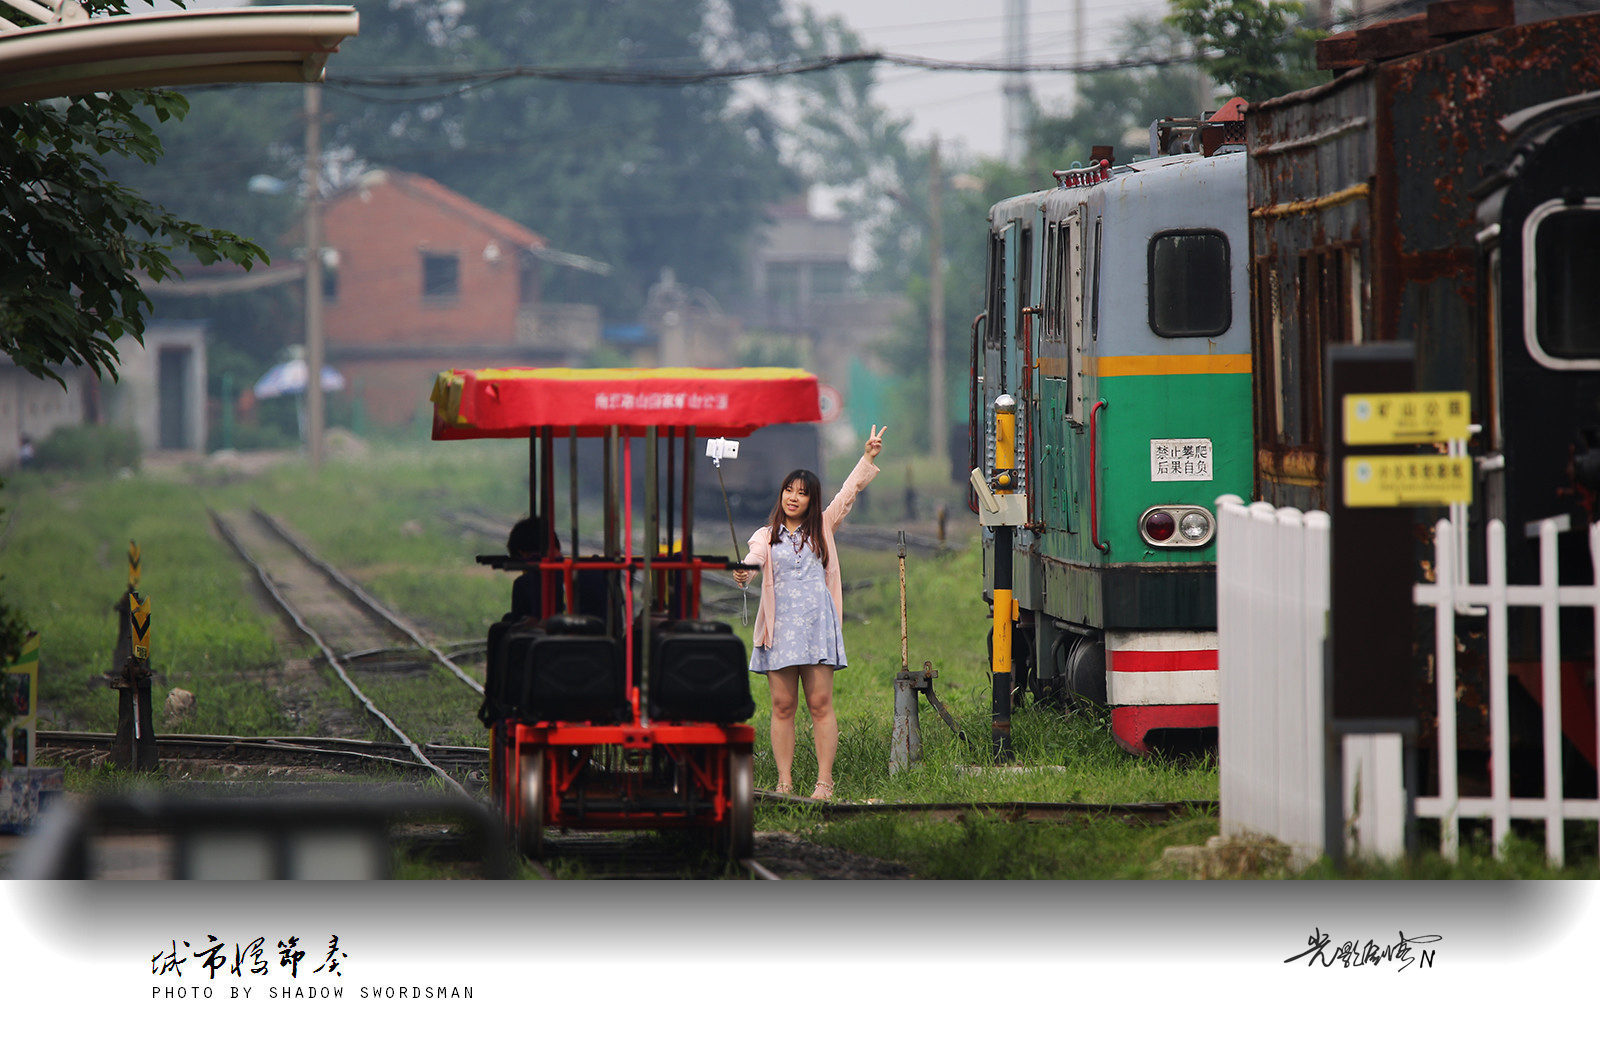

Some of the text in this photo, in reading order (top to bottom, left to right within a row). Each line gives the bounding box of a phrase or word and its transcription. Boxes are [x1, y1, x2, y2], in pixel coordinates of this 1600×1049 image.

[1156, 445, 1208, 459] 禁止攀爬
[1157, 460, 1208, 475] 后果自负
